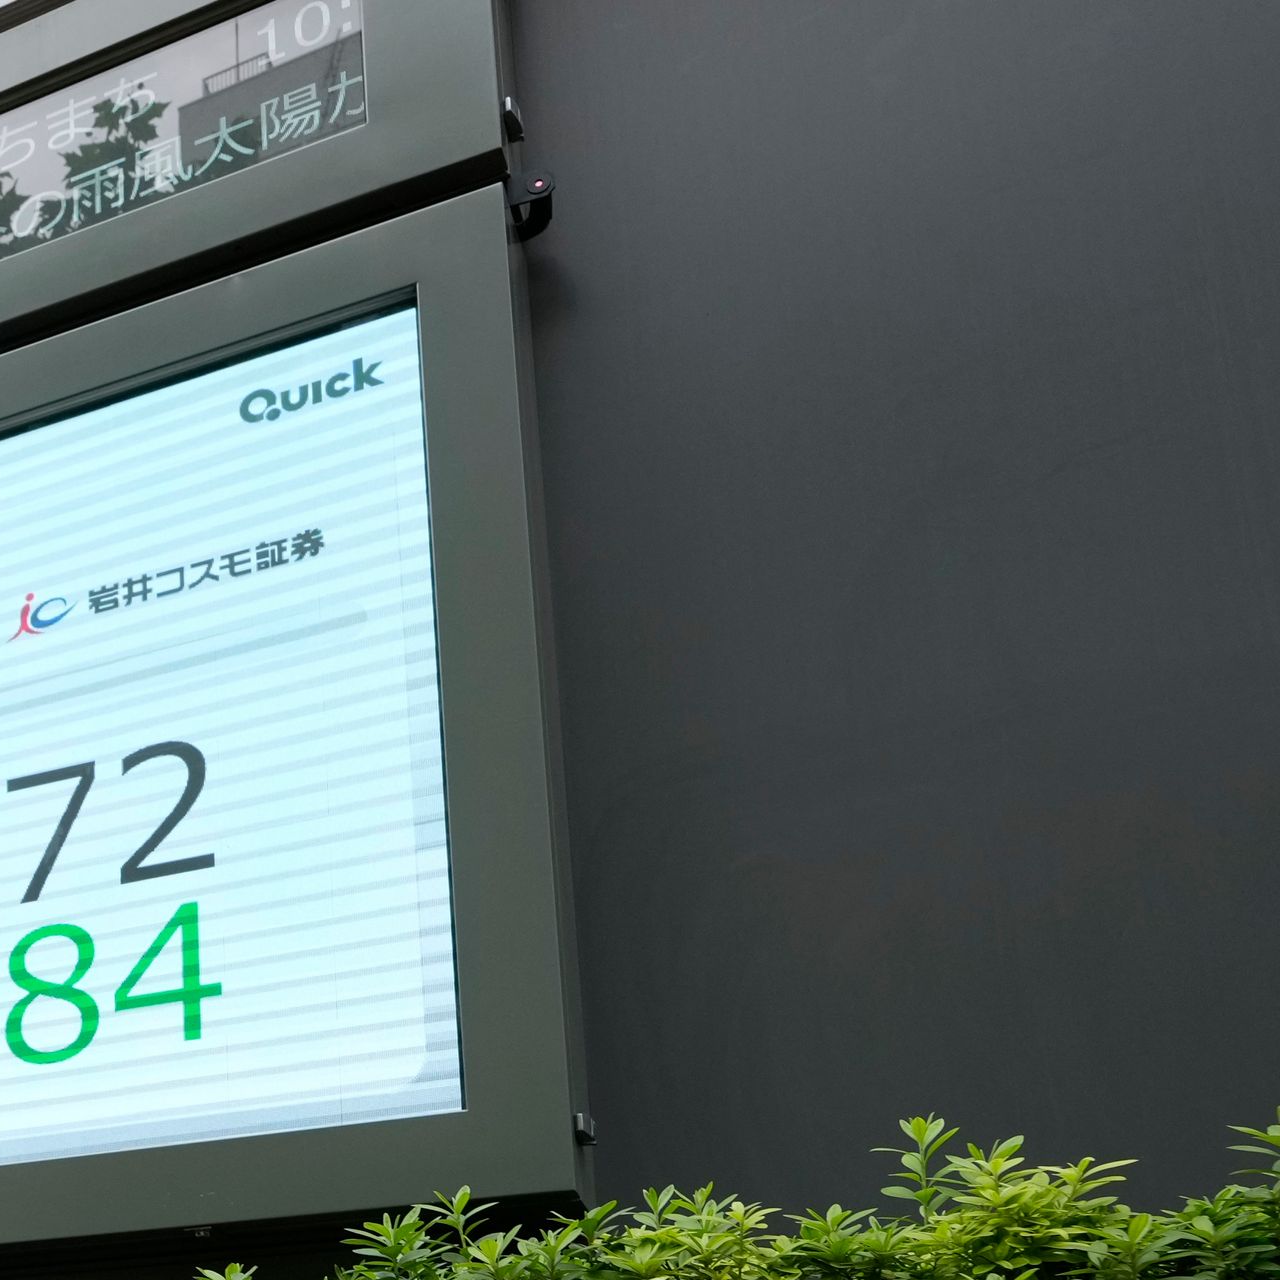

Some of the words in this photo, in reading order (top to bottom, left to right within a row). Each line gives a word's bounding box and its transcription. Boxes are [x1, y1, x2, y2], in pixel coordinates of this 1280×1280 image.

[88, 527, 325, 615] 岩井コスモ証券
